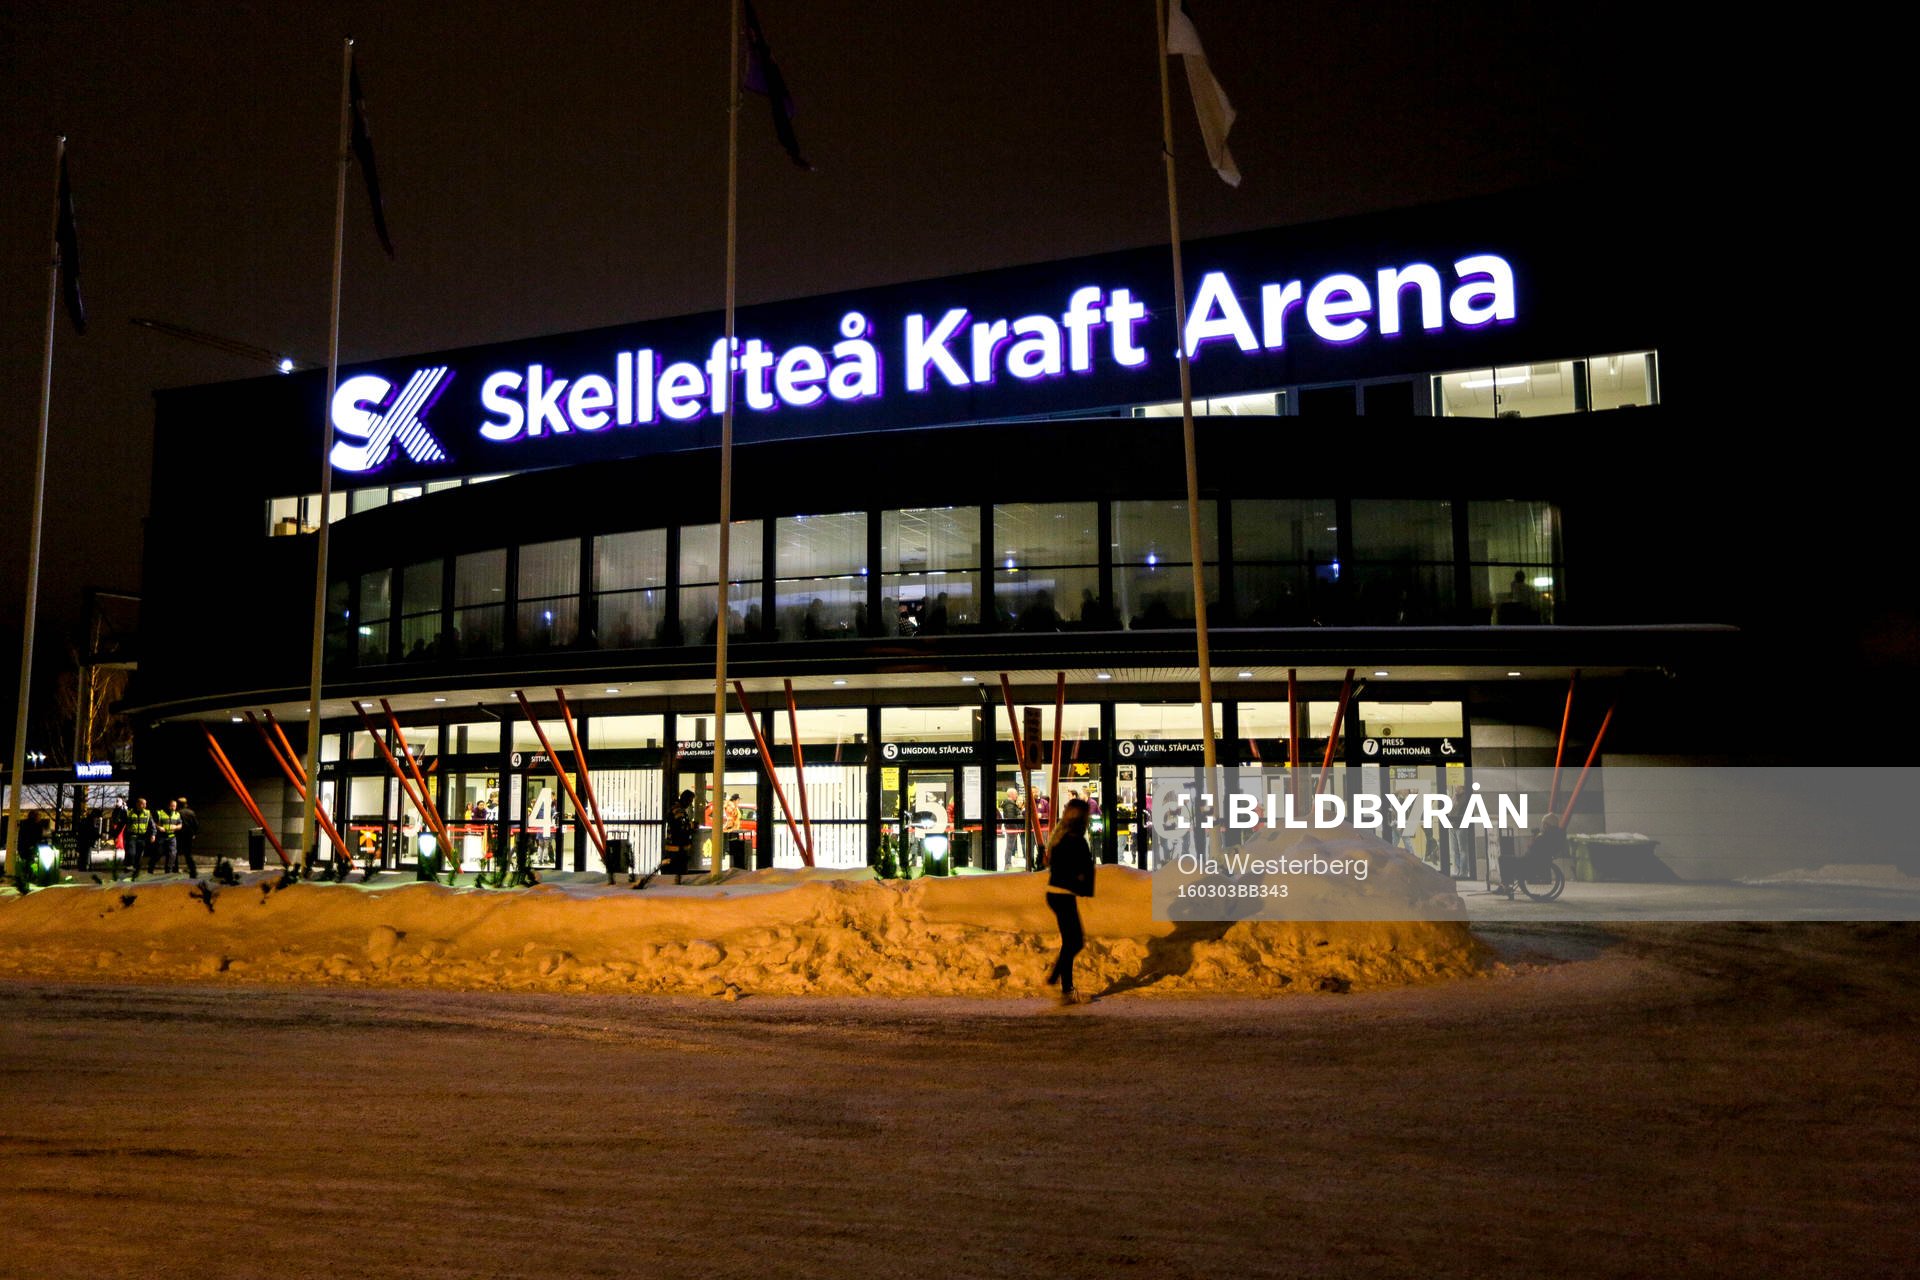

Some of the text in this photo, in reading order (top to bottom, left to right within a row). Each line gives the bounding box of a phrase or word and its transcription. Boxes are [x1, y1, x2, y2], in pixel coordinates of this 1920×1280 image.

[479, 255, 1516, 441] Skellefteå Kraft Arena
[887, 743, 974, 758] 5 UNGDOM, STÅPLATS
[1122, 742, 1205, 755] 6 VUXEN, STÅPLATS
[1366, 740, 1376, 753] 7
[1382, 747, 1431, 755] FUNKTIONÄR
[528, 787, 552, 838] 4
[914, 783, 949, 838] 5
